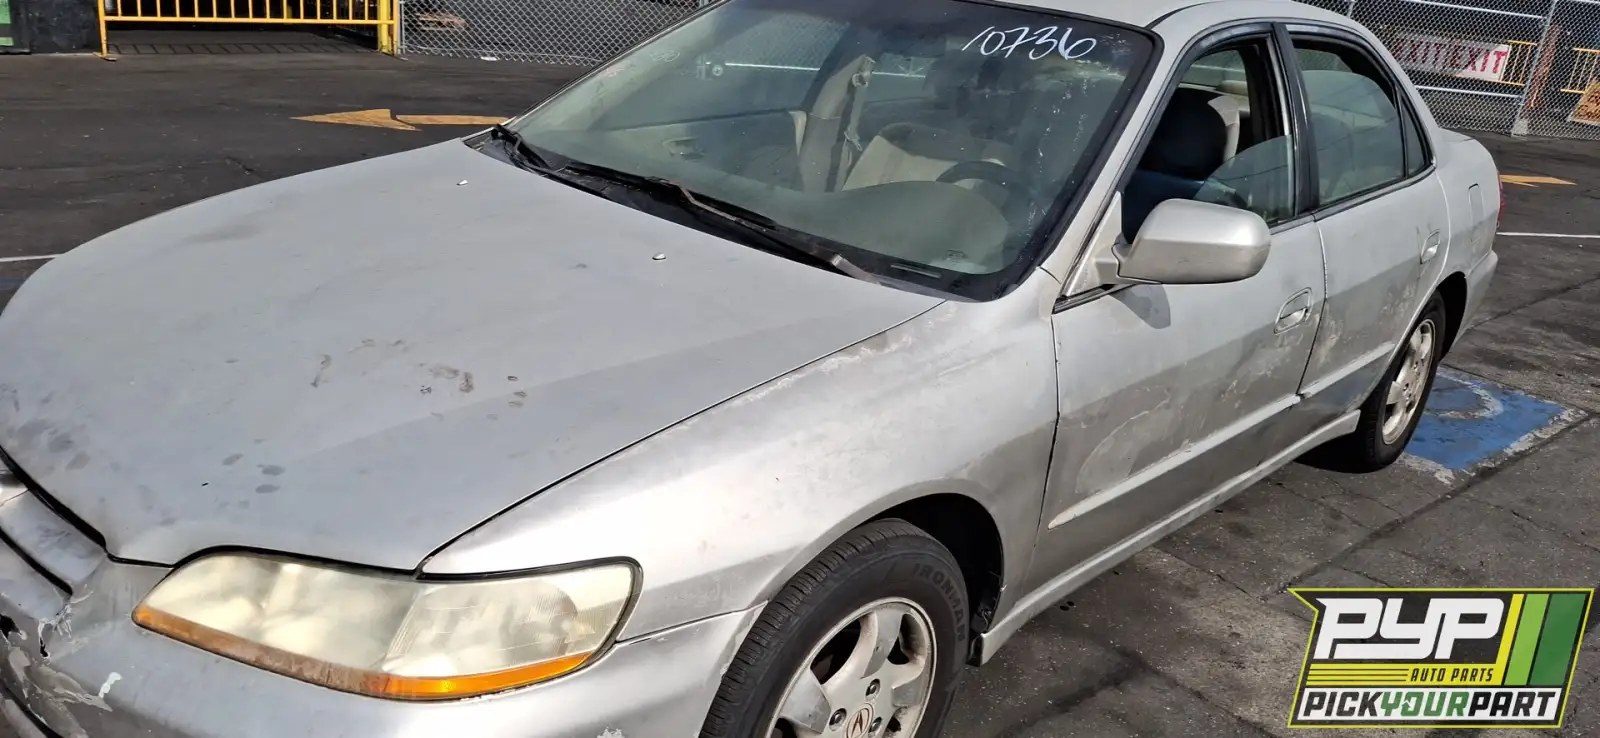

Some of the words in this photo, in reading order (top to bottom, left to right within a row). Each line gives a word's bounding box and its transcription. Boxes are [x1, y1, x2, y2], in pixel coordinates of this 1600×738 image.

[961, 26, 1097, 60] 10736
[1441, 42, 1508, 74] EXIT
[911, 562, 966, 642] IRONMAN
